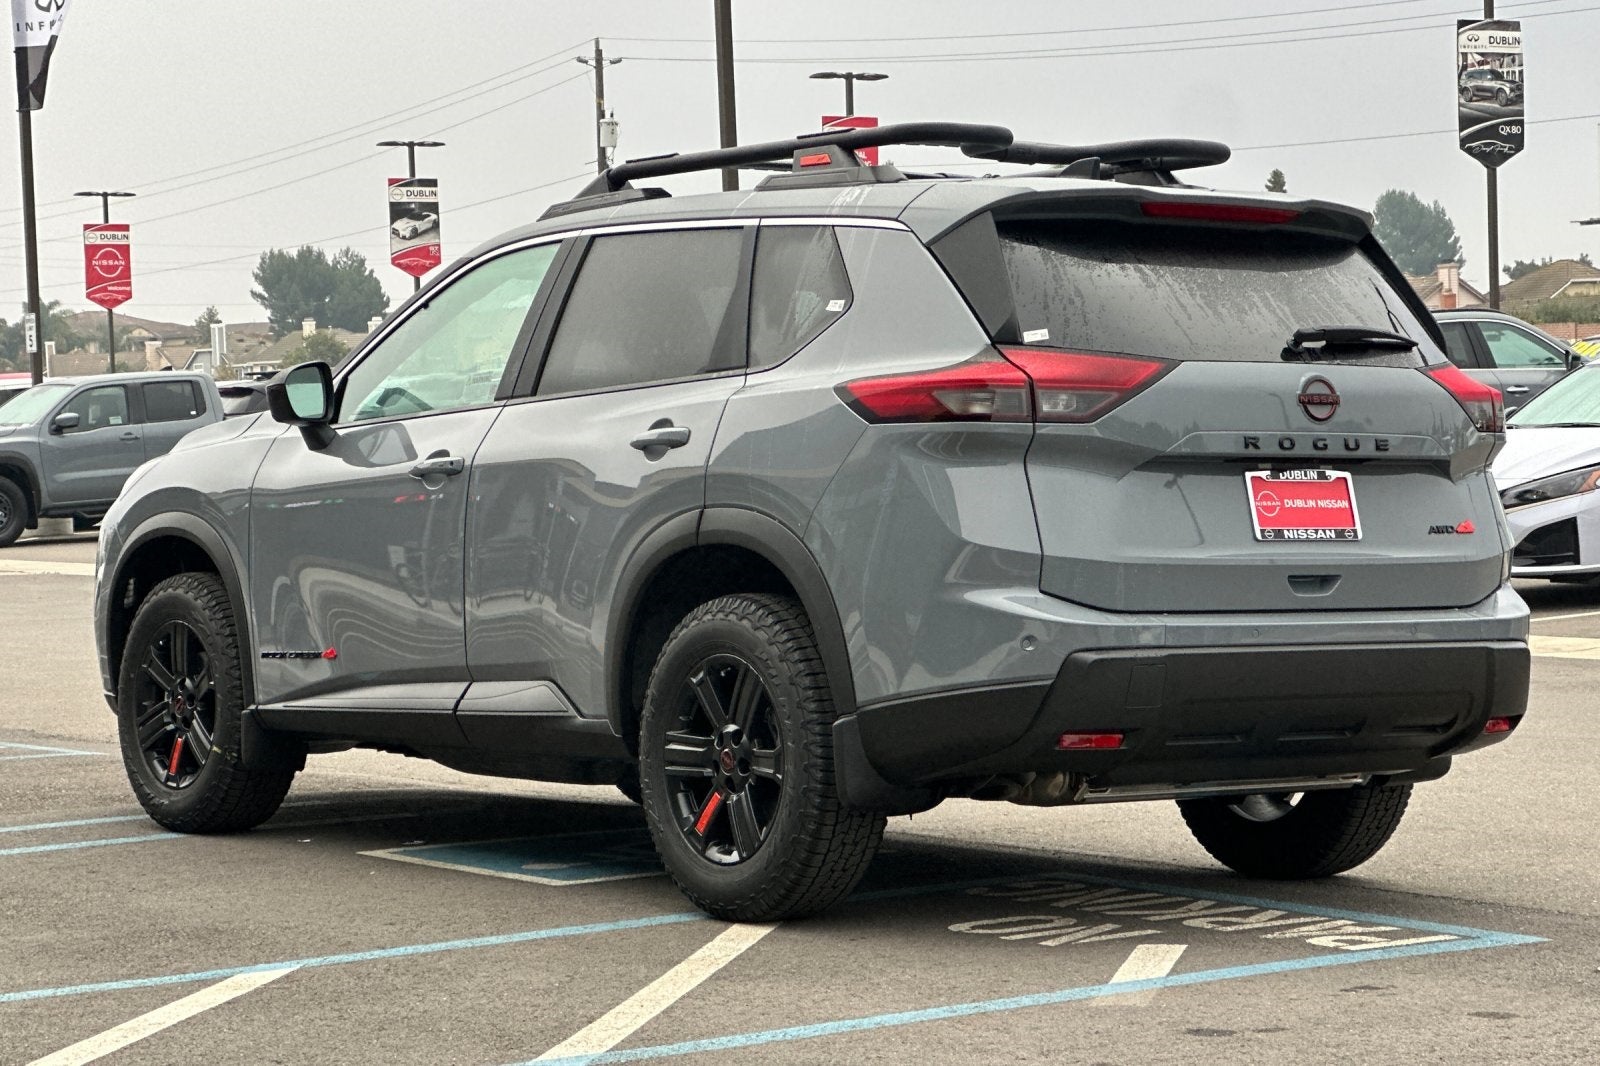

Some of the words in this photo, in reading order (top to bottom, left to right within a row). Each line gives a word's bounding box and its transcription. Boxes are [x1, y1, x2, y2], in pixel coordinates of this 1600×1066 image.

[1488, 35, 1520, 46] DUBLIN
[1498, 125, 1522, 136] QX80
[405, 189, 437, 198] DUBLIN
[99, 233, 129, 241] DUBLIN
[1300, 394, 1341, 405] NISSAN
[1243, 435, 1391, 452] ROGUE
[1279, 470, 1318, 480] DUBLIN
[1284, 499, 1316, 508] DUBLIN
[1317, 500, 1349, 509] NISSAN
[1283, 529, 1336, 539] NISSAN
[965, 880, 1462, 951] PARKING
[947, 915, 1164, 947] NO
